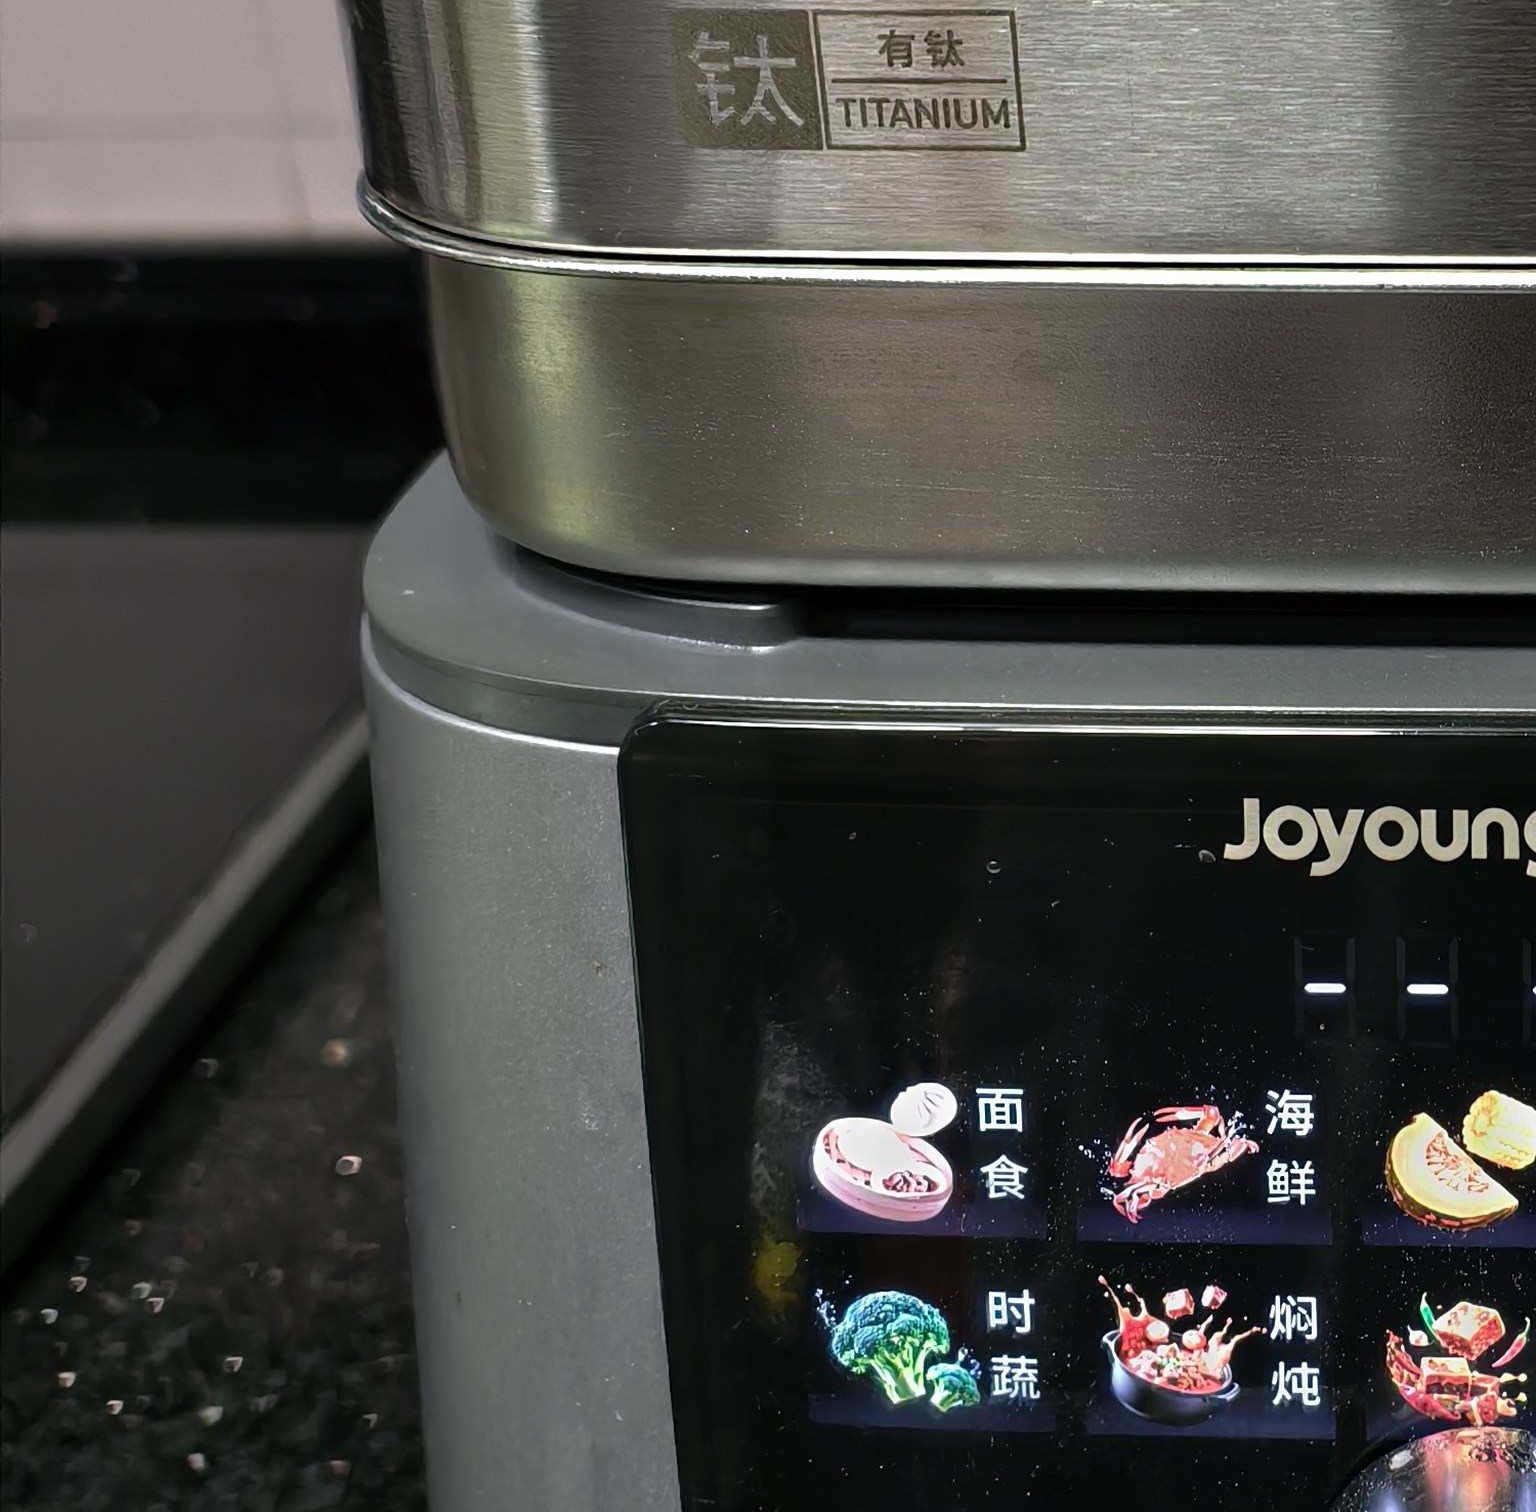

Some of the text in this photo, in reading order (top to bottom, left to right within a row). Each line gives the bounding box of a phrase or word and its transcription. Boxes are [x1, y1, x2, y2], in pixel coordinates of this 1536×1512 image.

[687, 31, 805, 126] 钛
[876, 28, 966, 68] 有钛
[835, 96, 1012, 130] TITANIUM
[975, 1086, 1030, 1201] 面食
[1264, 1088, 1318, 1207] 海鲜
[986, 1288, 1042, 1401] 时蔬
[1268, 1293, 1322, 1408] 焖炖
